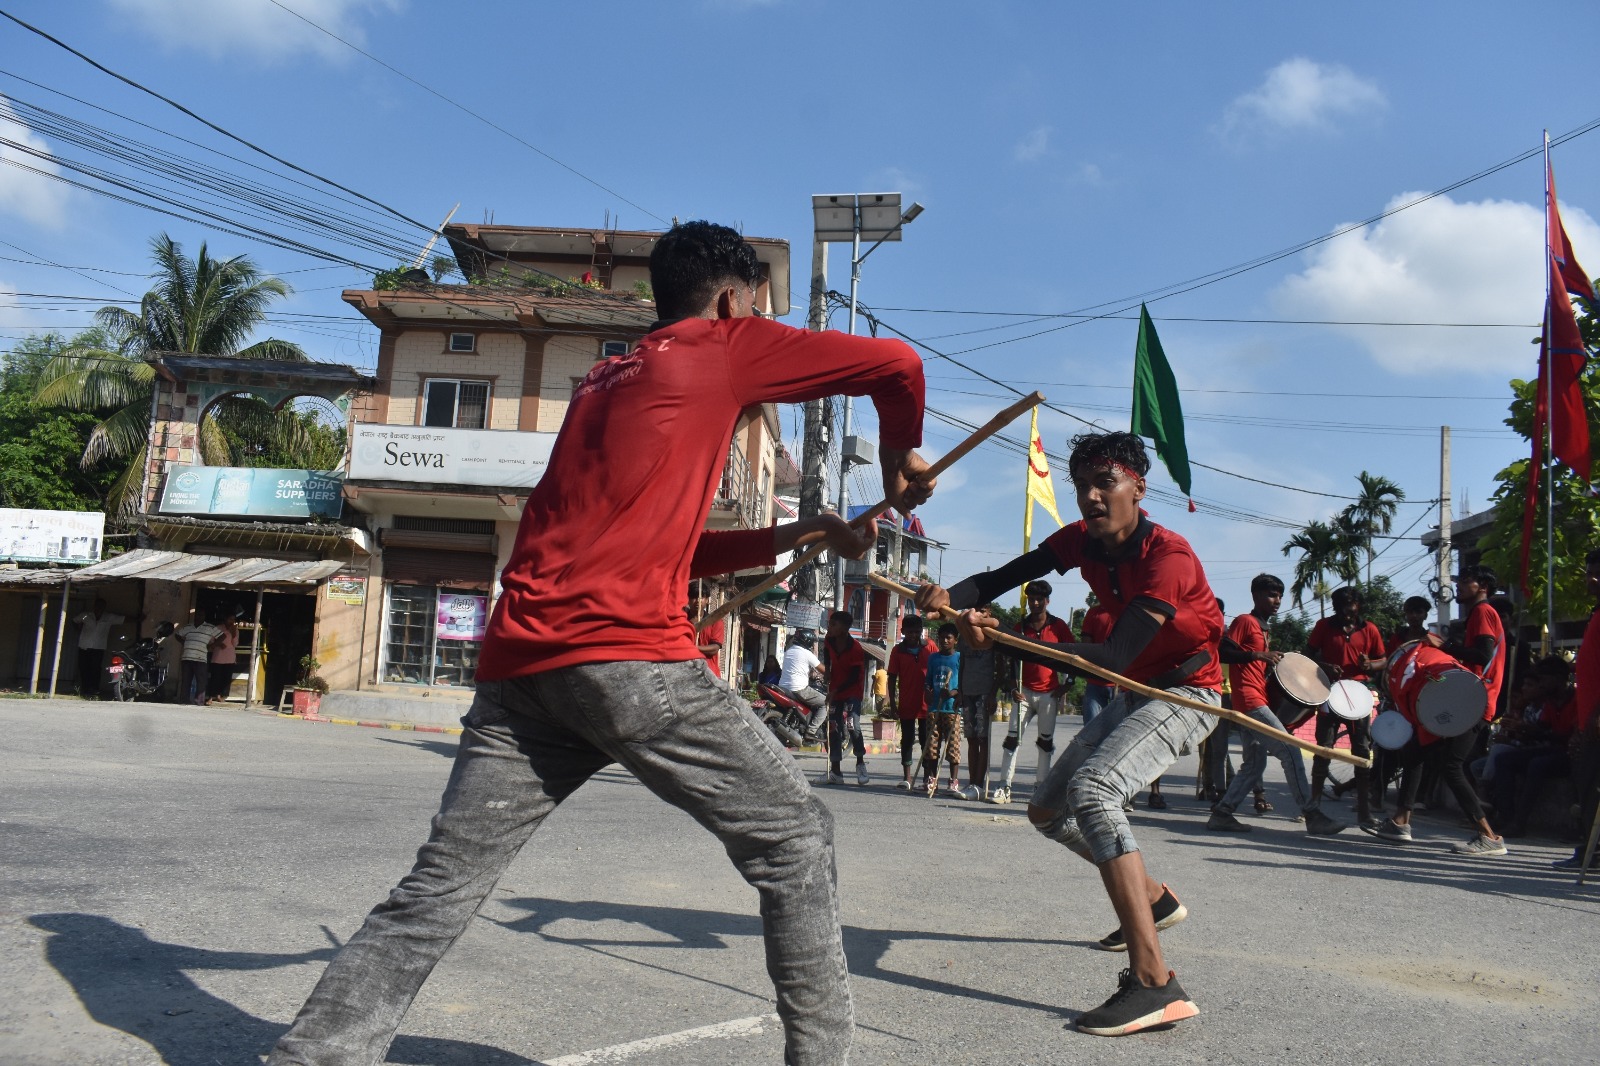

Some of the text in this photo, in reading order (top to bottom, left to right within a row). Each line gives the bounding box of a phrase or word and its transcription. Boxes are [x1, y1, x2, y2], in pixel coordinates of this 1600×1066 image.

[383, 441, 445, 469] Sewa
[277, 479, 334, 490] SARADHA
[275, 490, 336, 501] SUPPLIERS
